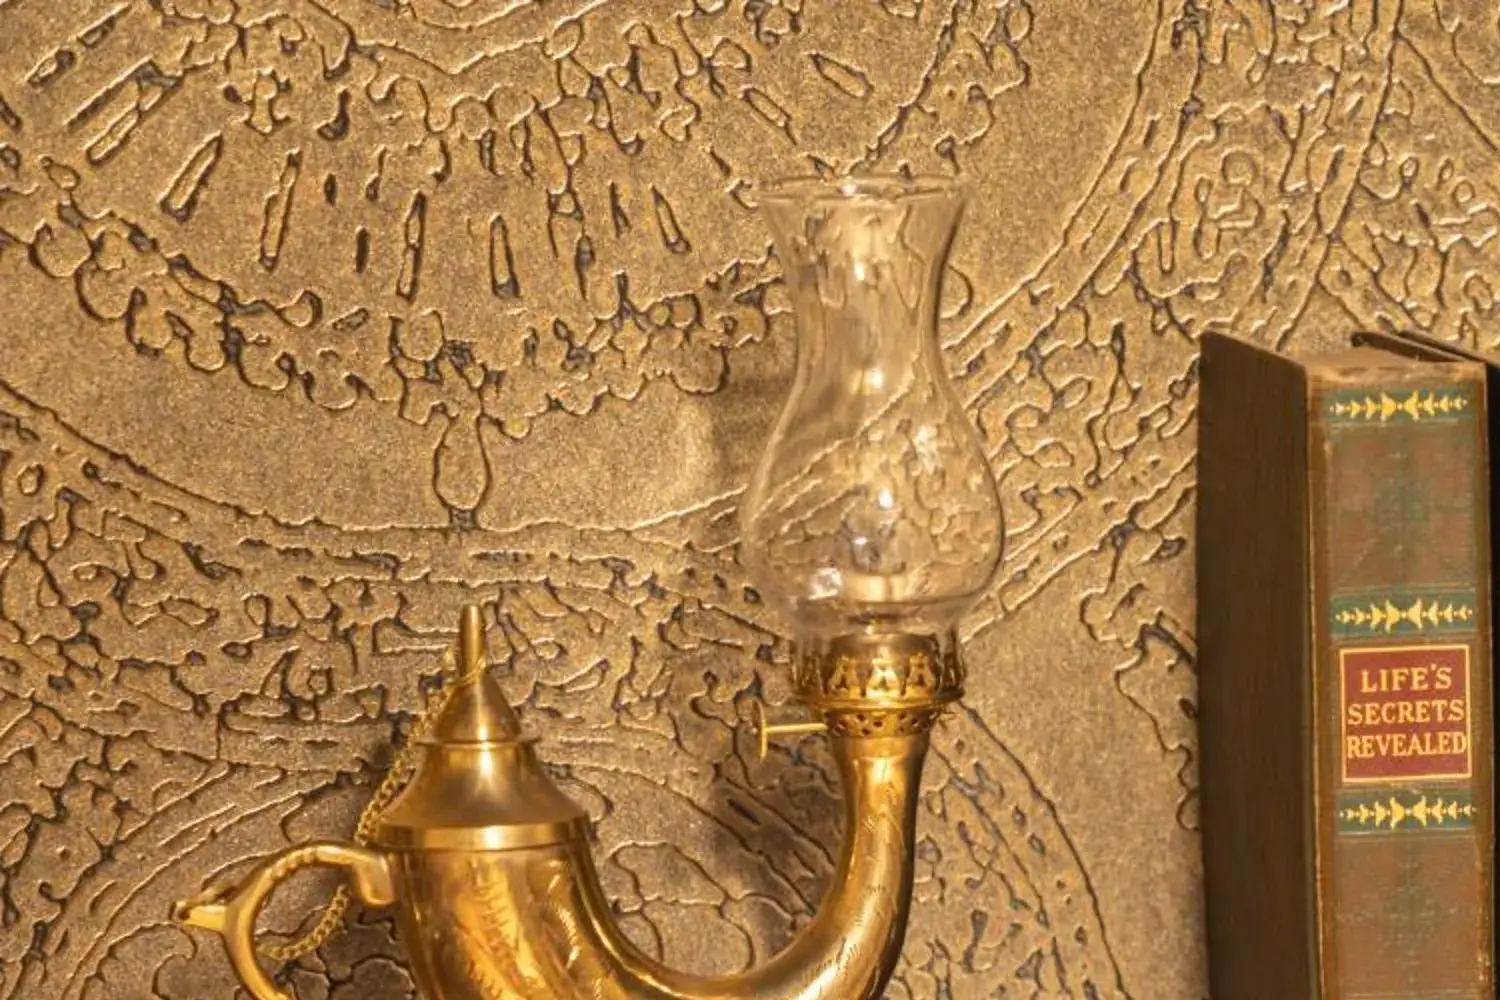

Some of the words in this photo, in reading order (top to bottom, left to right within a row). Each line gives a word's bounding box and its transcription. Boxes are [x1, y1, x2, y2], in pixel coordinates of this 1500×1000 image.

[1360, 664, 1453, 693] LIFE'S
[1347, 699, 1465, 725] SECRETS
[1346, 731, 1467, 759] REVEALED
